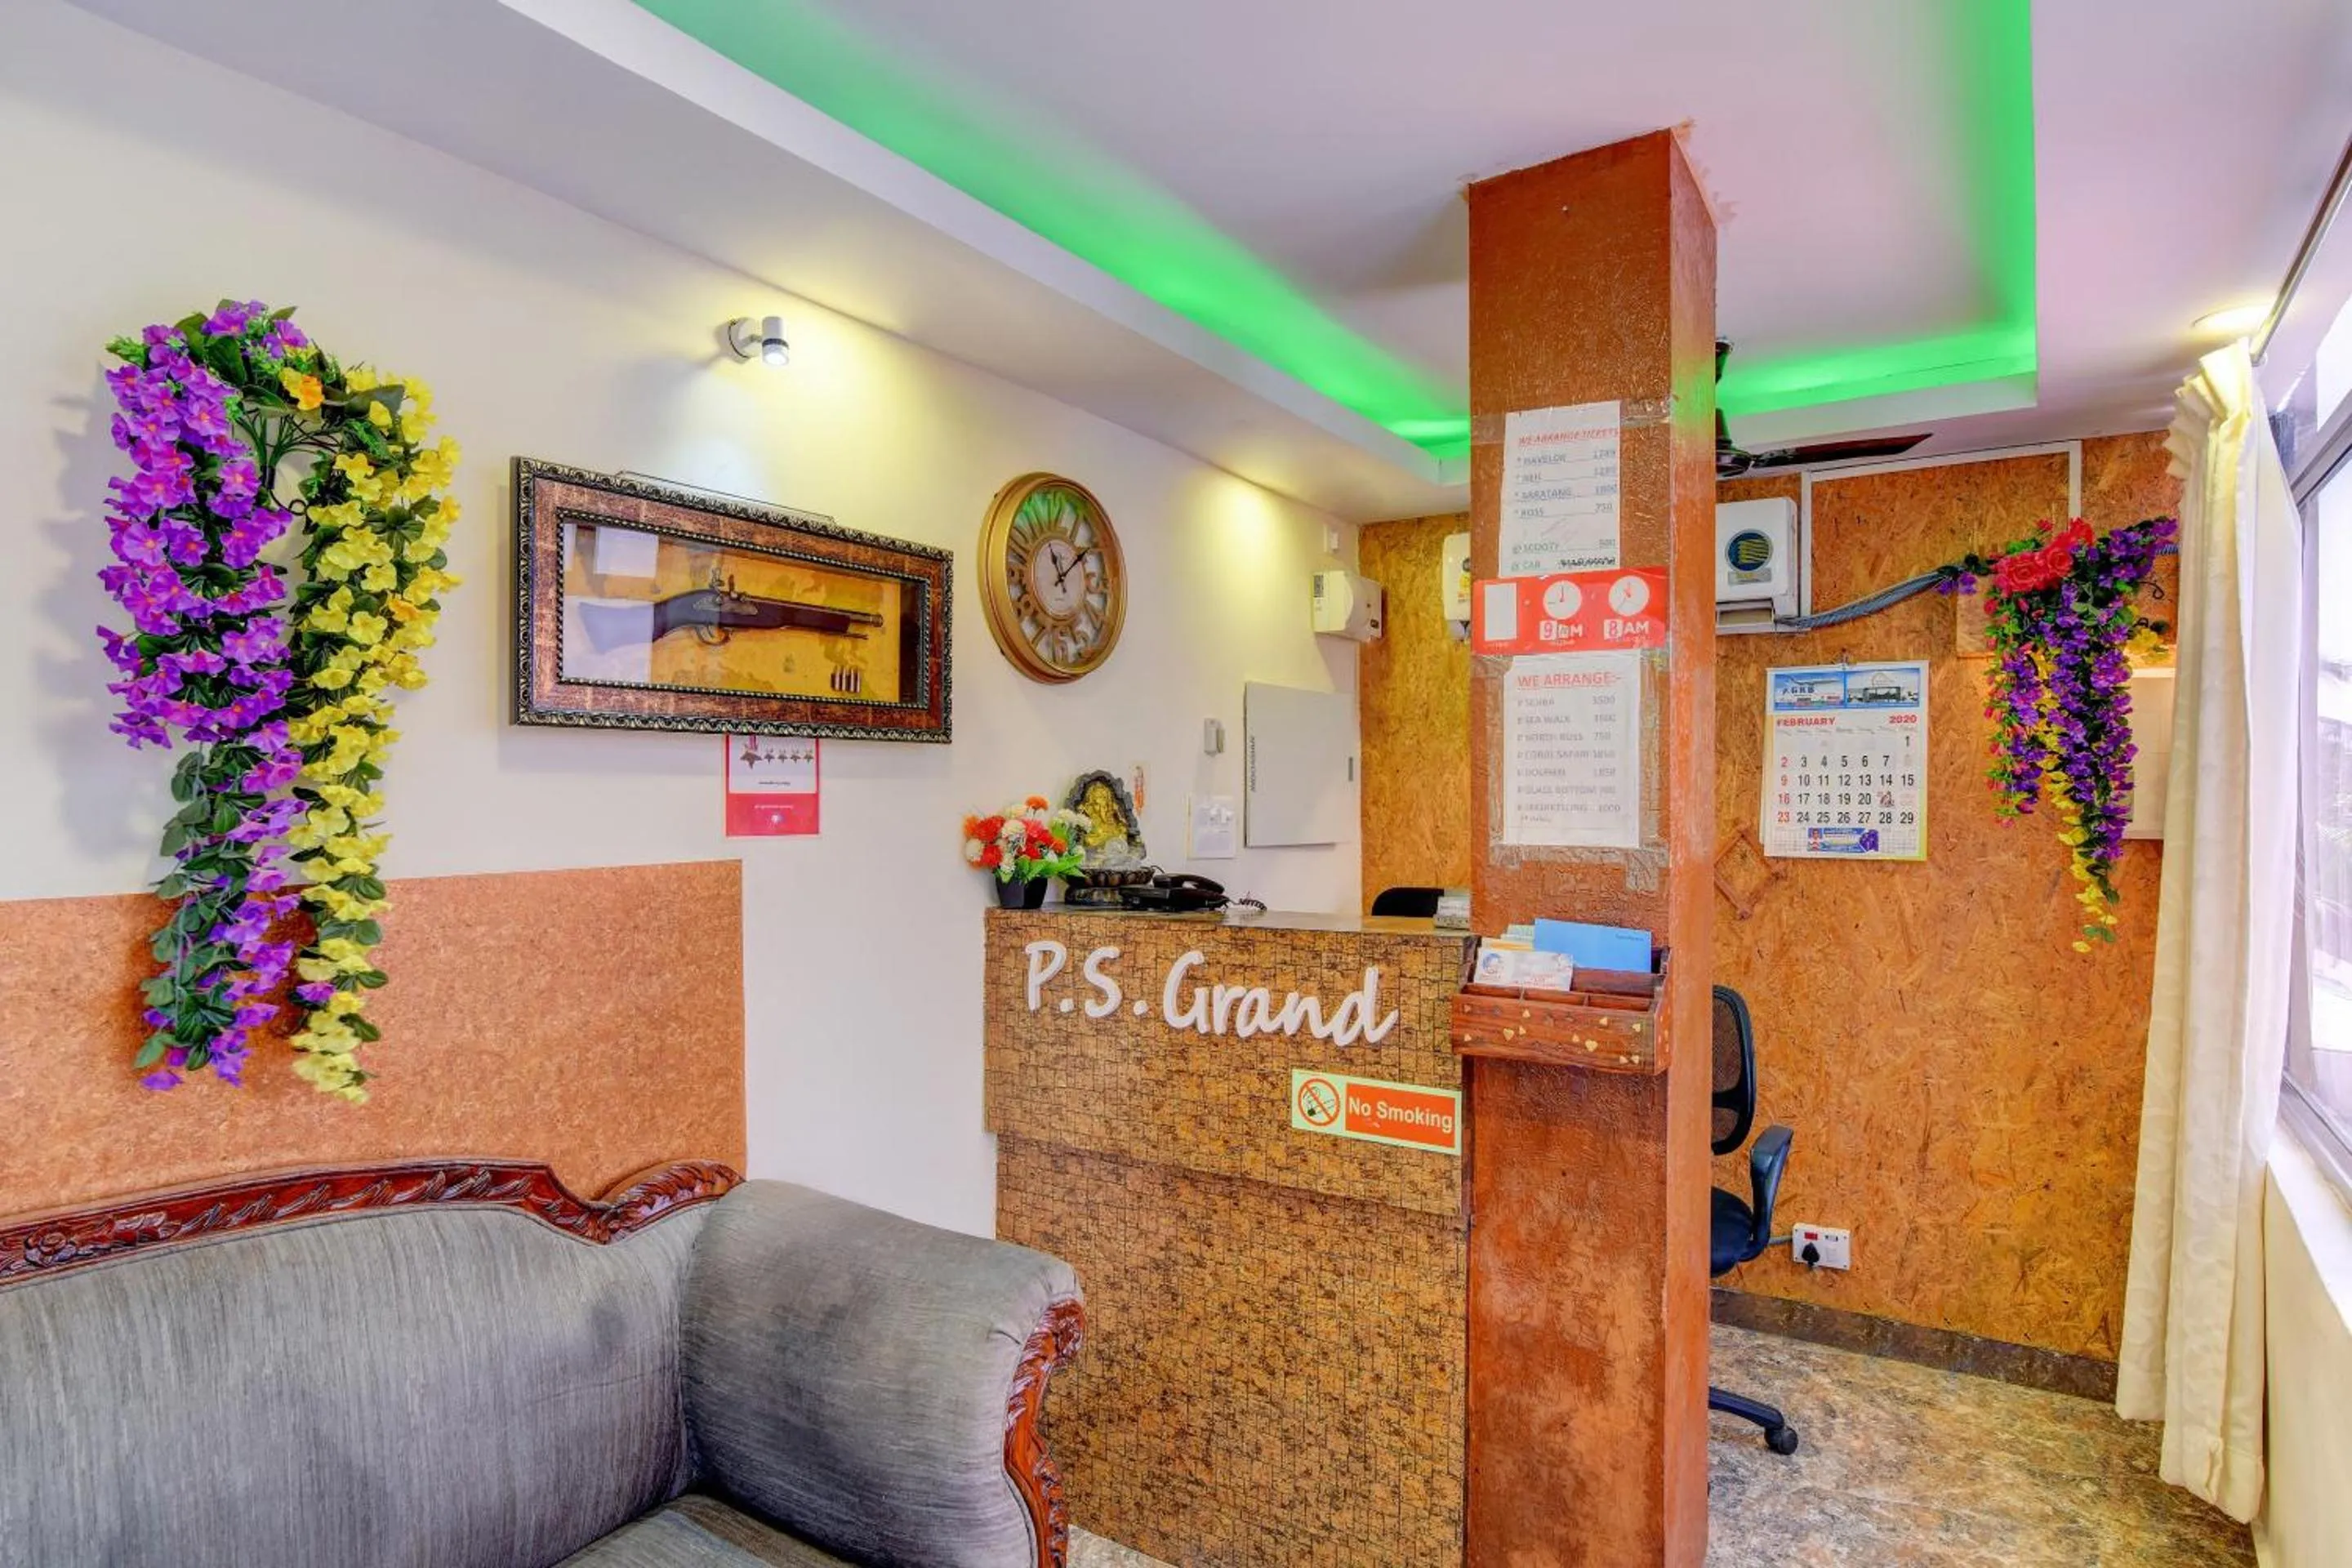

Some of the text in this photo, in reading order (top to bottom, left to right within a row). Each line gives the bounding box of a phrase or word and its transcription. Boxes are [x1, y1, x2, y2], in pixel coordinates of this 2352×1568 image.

[1517, 675, 1539, 687] WE
[1776, 714, 1918, 727] FEBRUARY 2020
[1781, 755, 1788, 768] 2
[1801, 755, 1807, 768] 3
[1820, 755, 1828, 768] 4
[1842, 755, 1848, 768] 5
[1862, 755, 1869, 768] 6
[1882, 755, 1890, 768] 7
[1780, 774, 1914, 786] 9 10 11 12 13 14 15
[1778, 793, 1790, 805] 16
[1797, 793, 1810, 805] 17
[1818, 793, 1830, 805] 18
[1838, 793, 1851, 805] 19
[1858, 793, 1871, 805] 20
[1778, 812, 1914, 824] 23 24 25 26 27 28 29
[1163, 950, 1399, 1047] Grand
[1348, 1097, 1453, 1134] No Smoking
